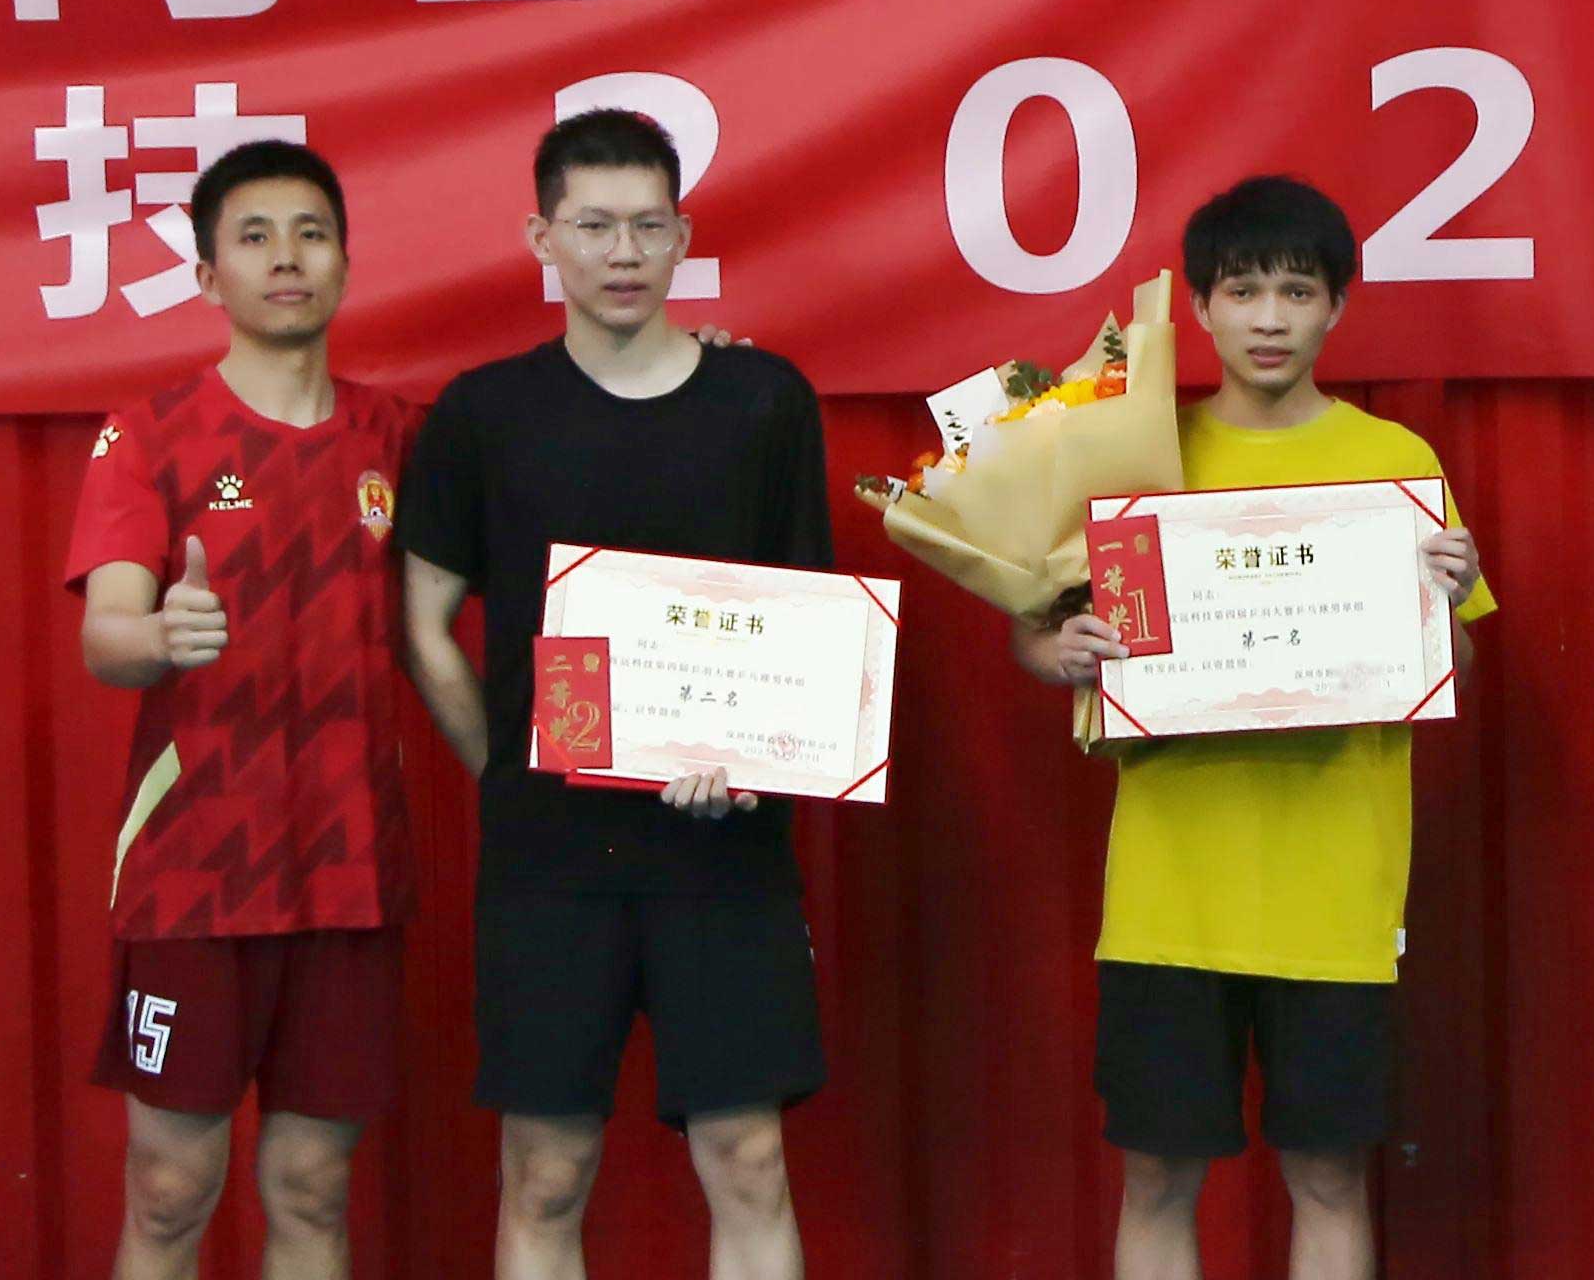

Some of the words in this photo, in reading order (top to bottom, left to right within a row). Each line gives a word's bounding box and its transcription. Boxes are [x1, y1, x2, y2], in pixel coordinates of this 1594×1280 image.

[209, 499, 253, 510] KELME
[1214, 543, 1314, 570] 荣誉证书
[665, 604, 765, 636] 荣誉证书
[1127, 588, 1159, 643] 1
[1241, 628, 1303, 649] 第一名
[679, 683, 739, 707] 第二名
[567, 701, 601, 752] 2
